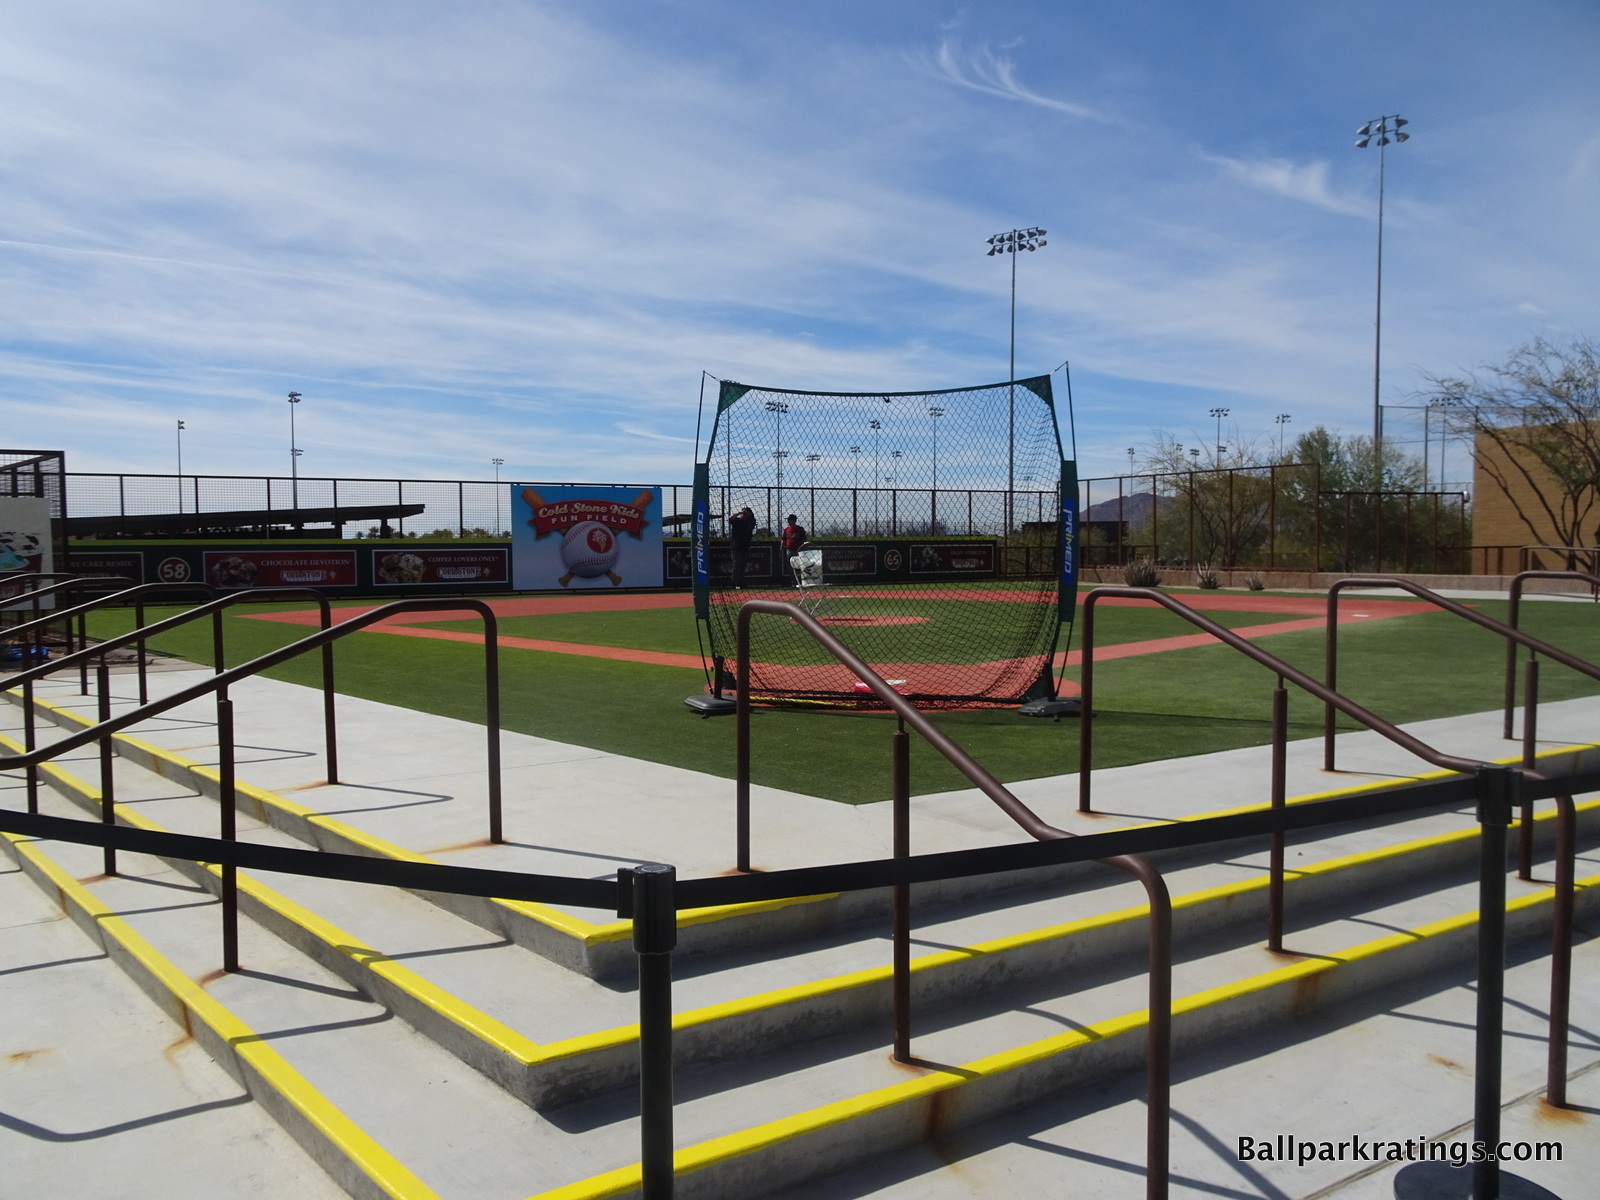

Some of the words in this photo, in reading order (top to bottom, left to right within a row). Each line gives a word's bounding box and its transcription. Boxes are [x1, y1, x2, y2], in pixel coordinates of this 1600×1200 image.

[538, 504, 569, 519] Cold
[571, 502, 608, 514] Stone
[610, 504, 640, 519] Kids
[551, 515, 578, 525] FUN
[587, 514, 627, 525] FIELD
[309, 558, 350, 566] DEVOTION
[162, 563, 185, 579] 58
